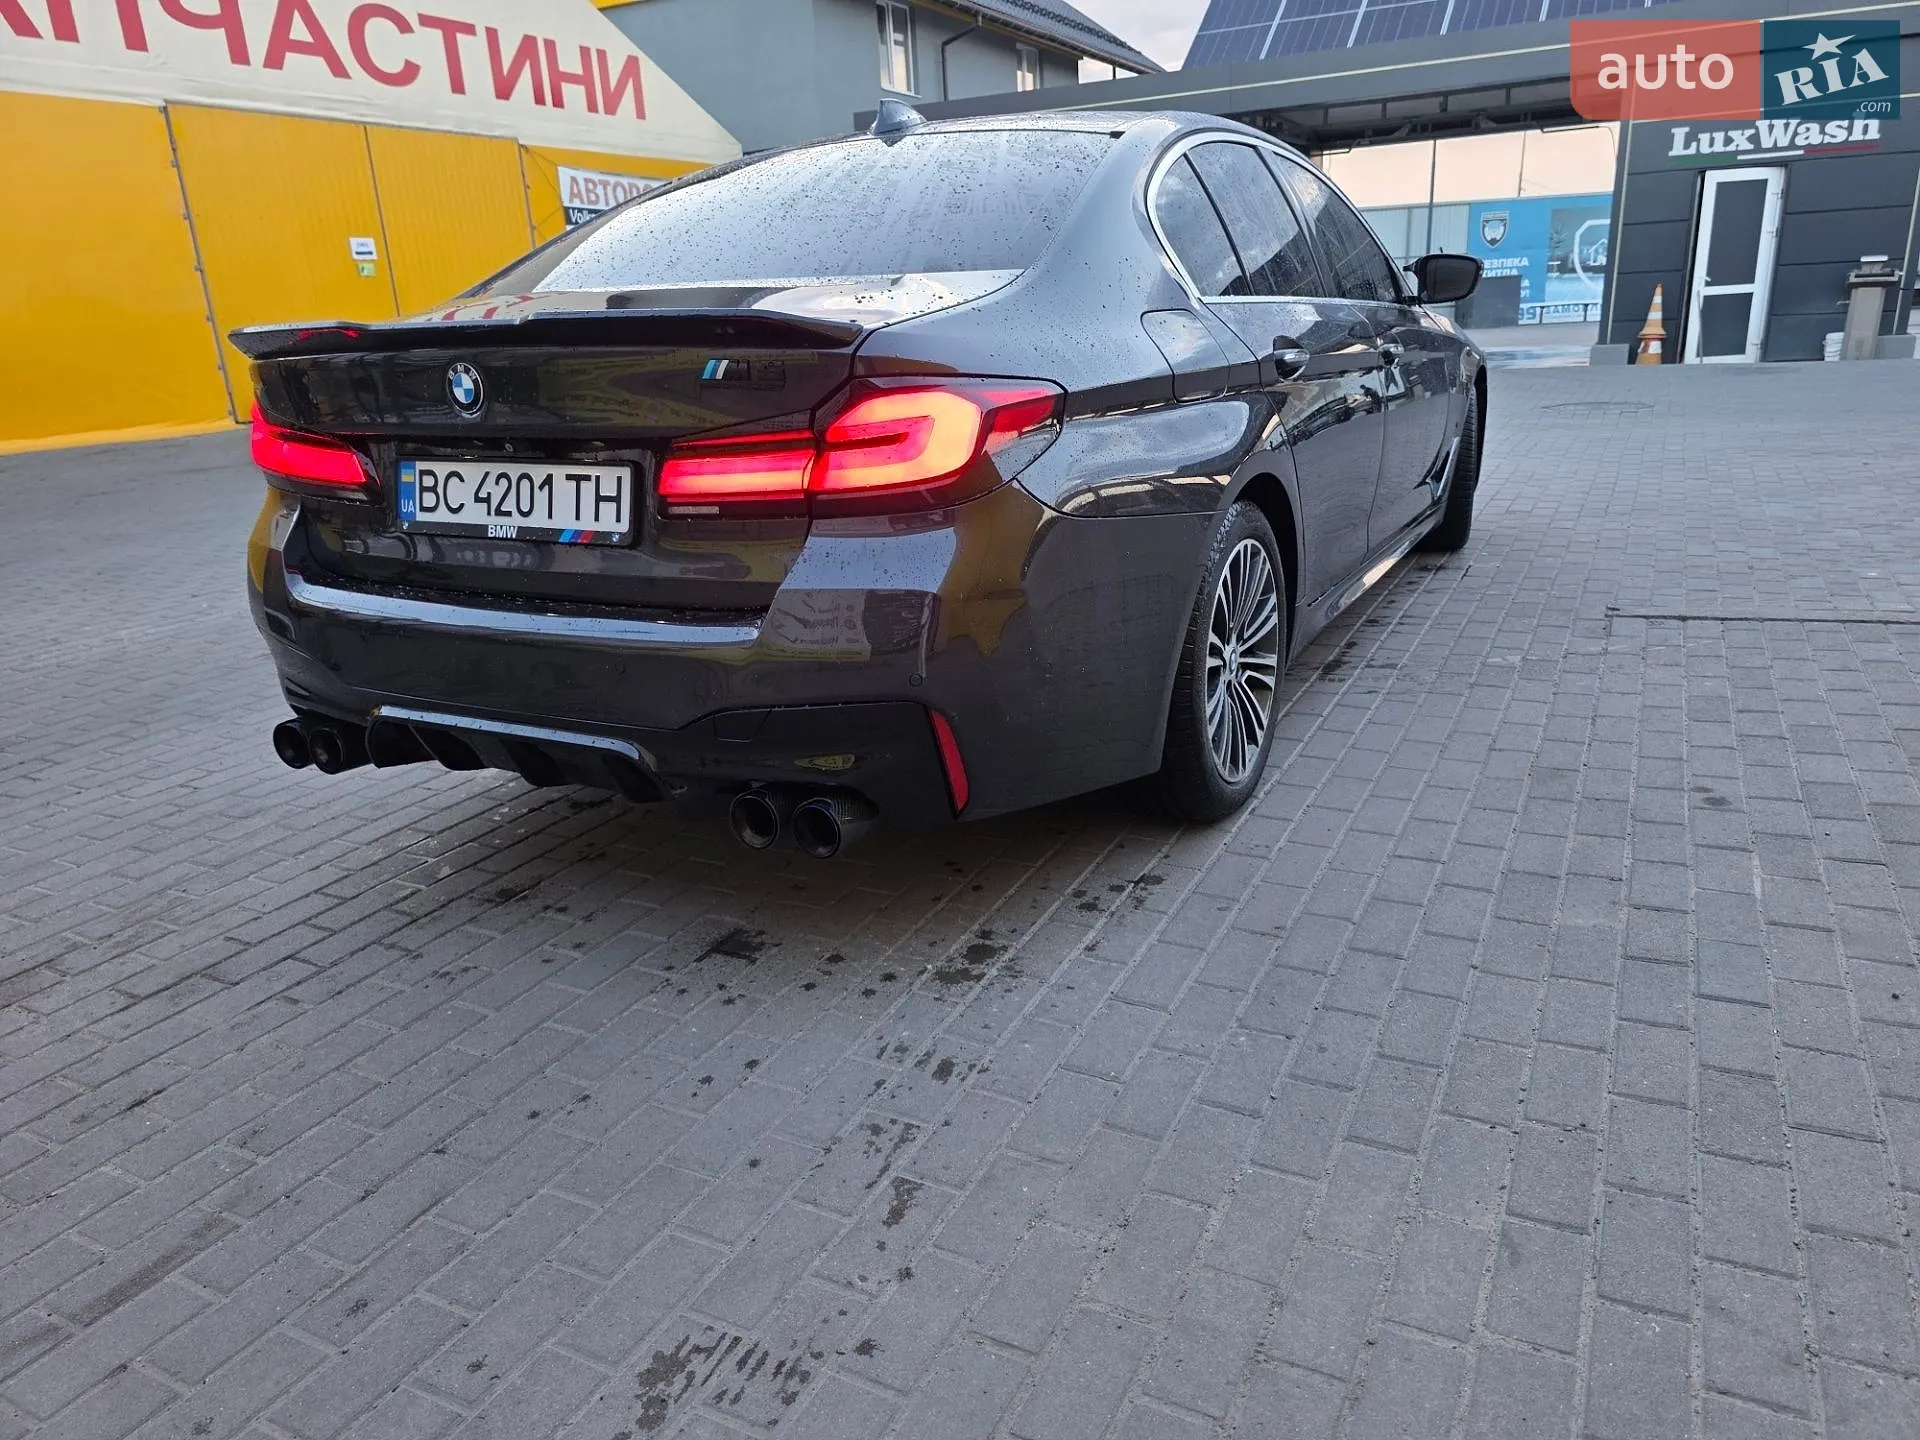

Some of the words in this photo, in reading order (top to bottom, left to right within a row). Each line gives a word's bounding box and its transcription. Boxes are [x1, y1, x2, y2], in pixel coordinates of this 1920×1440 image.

[0, 0, 646, 120] ПЧАСТИНИ
[1668, 111, 1881, 157] LuxWash
[569, 176, 653, 206] АВТОР
[1481, 257, 1529, 269] ЕЗПЕКА
[401, 501, 415, 513] UA
[418, 469, 466, 515] BC
[474, 471, 554, 521] 4201
[565, 473, 623, 524] TH
[488, 525, 518, 539] BMW
